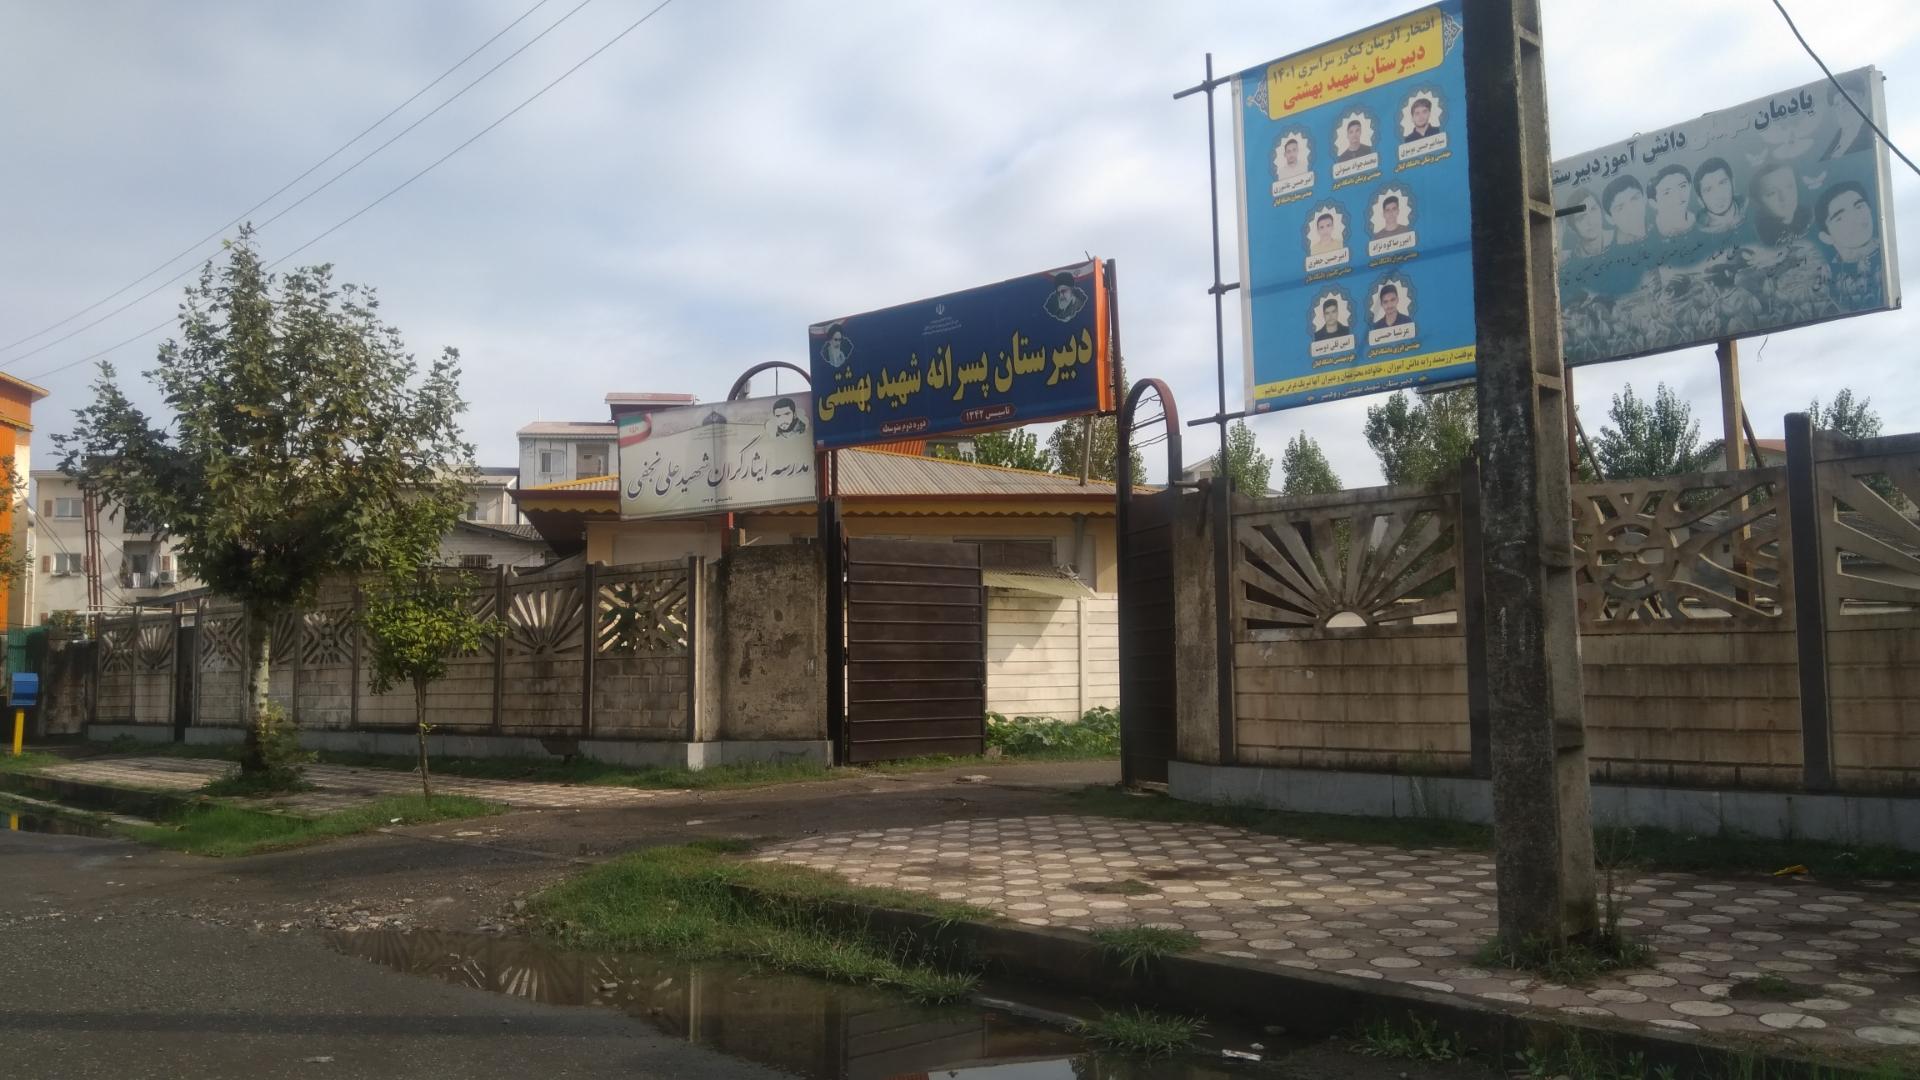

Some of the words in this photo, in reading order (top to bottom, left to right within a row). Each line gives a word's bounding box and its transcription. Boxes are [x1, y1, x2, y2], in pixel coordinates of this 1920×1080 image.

[1405, 16, 1434, 43] افتخار
[1298, 56, 1334, 79] سراسری
[1338, 41, 1364, 66] کنکور
[1364, 45, 1425, 84] دبیرستان
[1273, 64, 1295, 85] ۱۴۰۱
[1327, 65, 1359, 92] شهید
[1283, 81, 1323, 110] بهشتی
[1754, 89, 1813, 130] یادمان
[1601, 139, 1637, 177] آموز
[1642, 131, 1686, 163] دانش
[926, 344, 989, 401] پسرانه
[994, 328, 1093, 394] دبیرستان
[817, 366, 871, 422] بهشتی
[876, 352, 922, 409] شهید
[627, 451, 661, 499] نجفی
[655, 460, 679, 496] علی
[675, 452, 709, 493] شهید
[707, 434, 768, 488] ایثارگران
[771, 462, 809, 477] مدرسه
